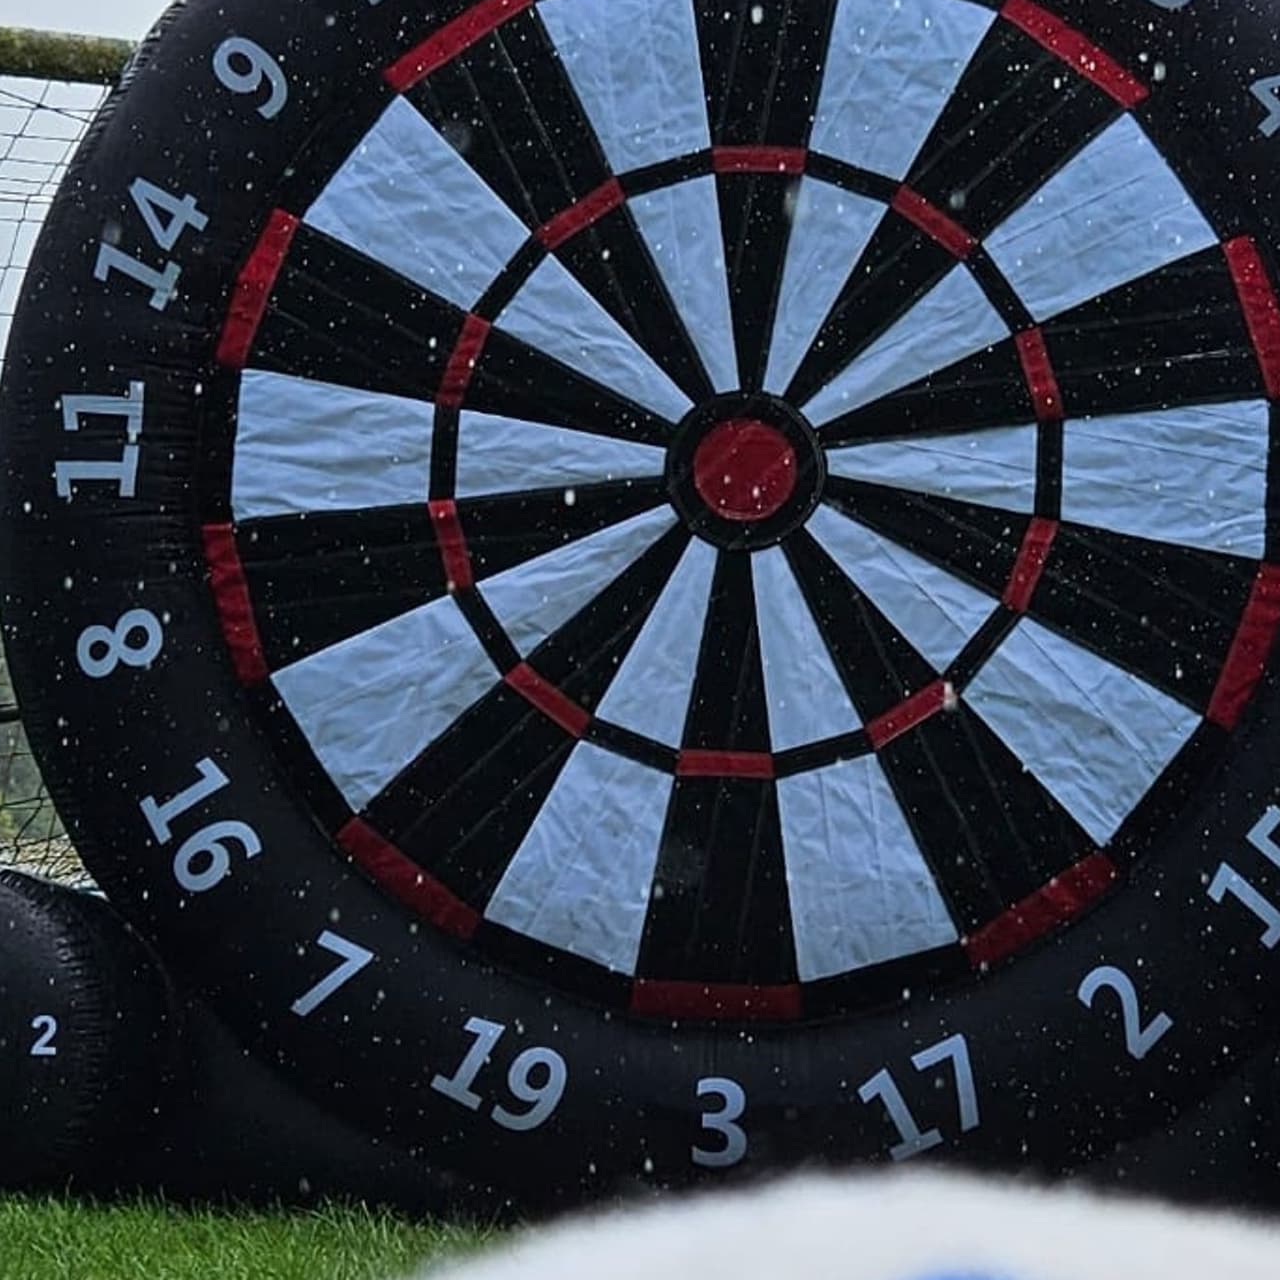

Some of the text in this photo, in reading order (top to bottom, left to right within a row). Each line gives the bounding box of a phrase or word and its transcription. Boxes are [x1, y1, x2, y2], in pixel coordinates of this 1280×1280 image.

[213, 36, 287, 118] 9
[94, 178, 208, 310] 14
[52, 381, 144, 502] 11
[77, 609, 163, 677] 8
[140, 757, 261, 891] 16
[292, 931, 374, 1015] 7
[1078, 966, 1172, 1058] 2
[31, 1015, 56, 1055] 2
[431, 1017, 567, 1130] 19
[693, 1077, 746, 1164] 3
[858, 1033, 978, 1168] 17
